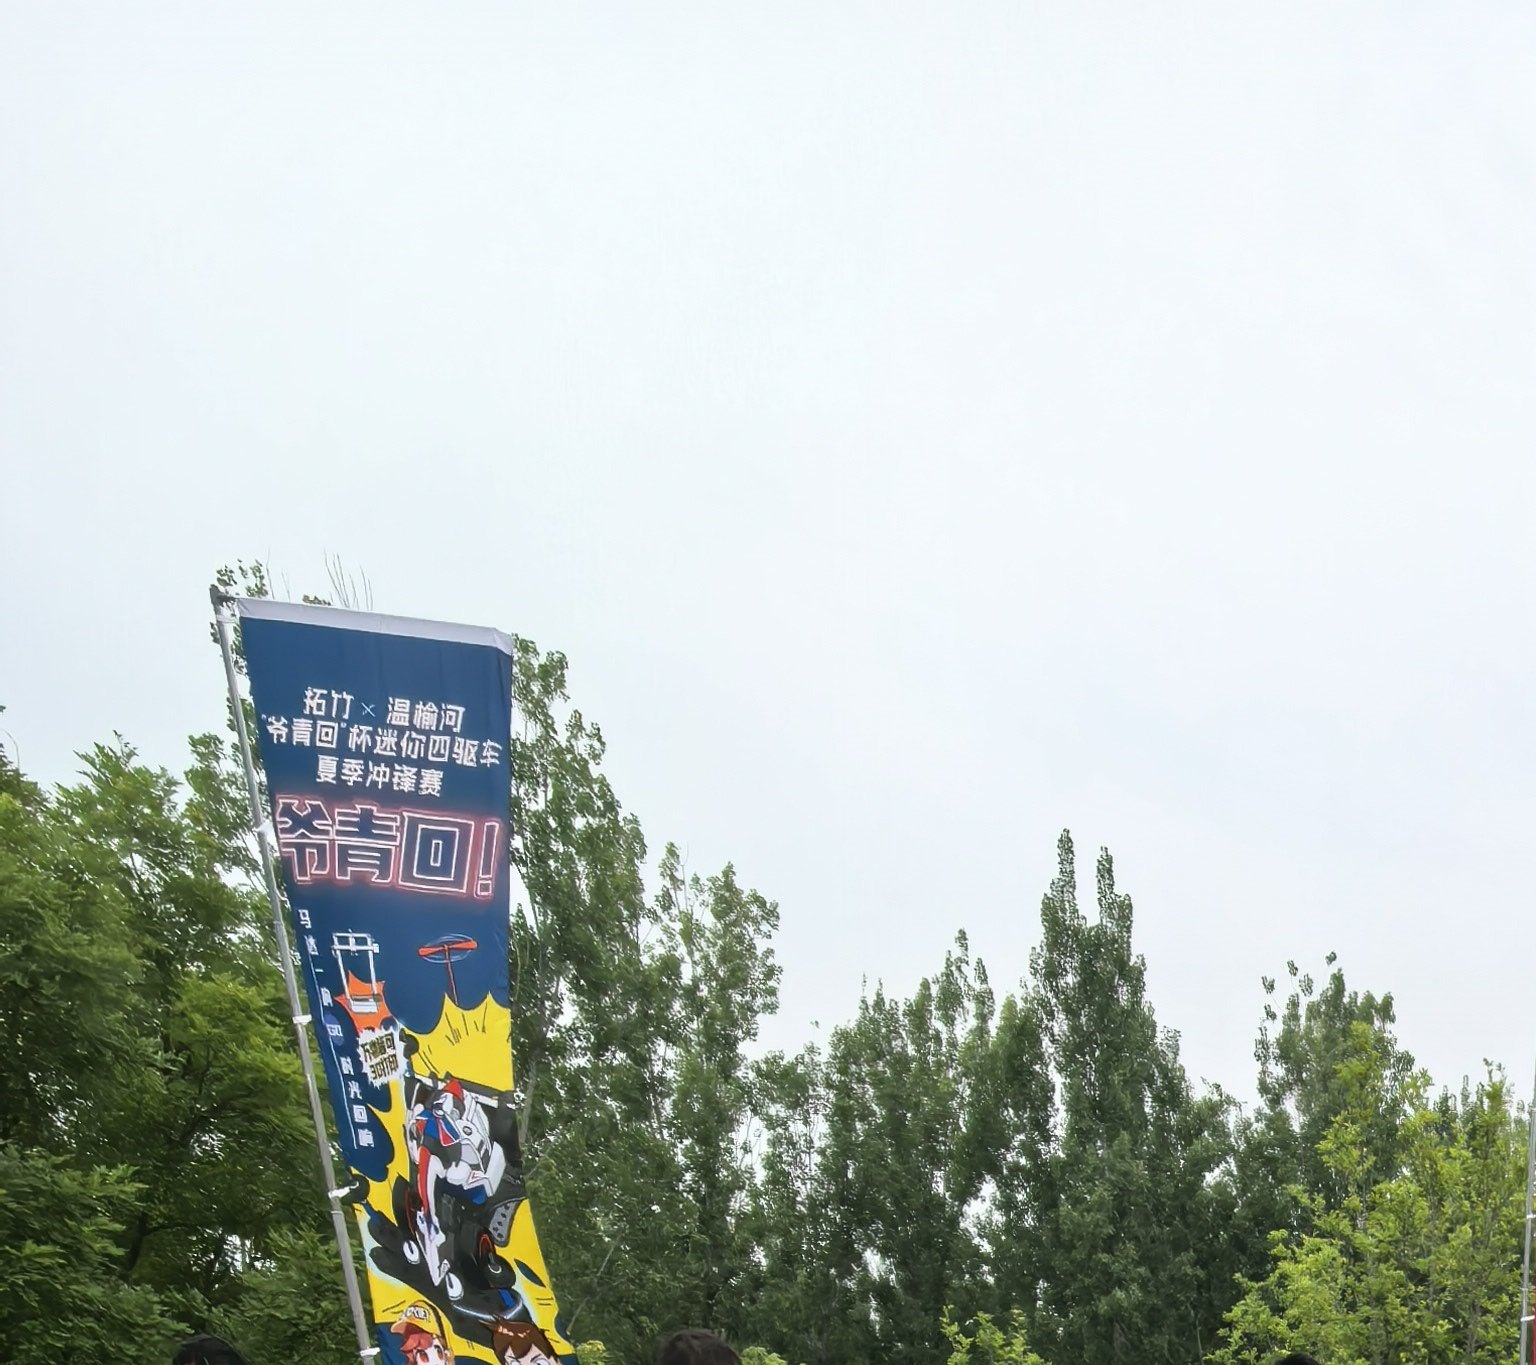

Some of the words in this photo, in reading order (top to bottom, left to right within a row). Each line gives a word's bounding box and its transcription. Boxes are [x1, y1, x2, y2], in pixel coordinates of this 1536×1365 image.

[303, 687, 354, 719] 拓竹
[386, 697, 466, 733] 温榆河
[315, 754, 444, 797] 夏季冲锋赛
